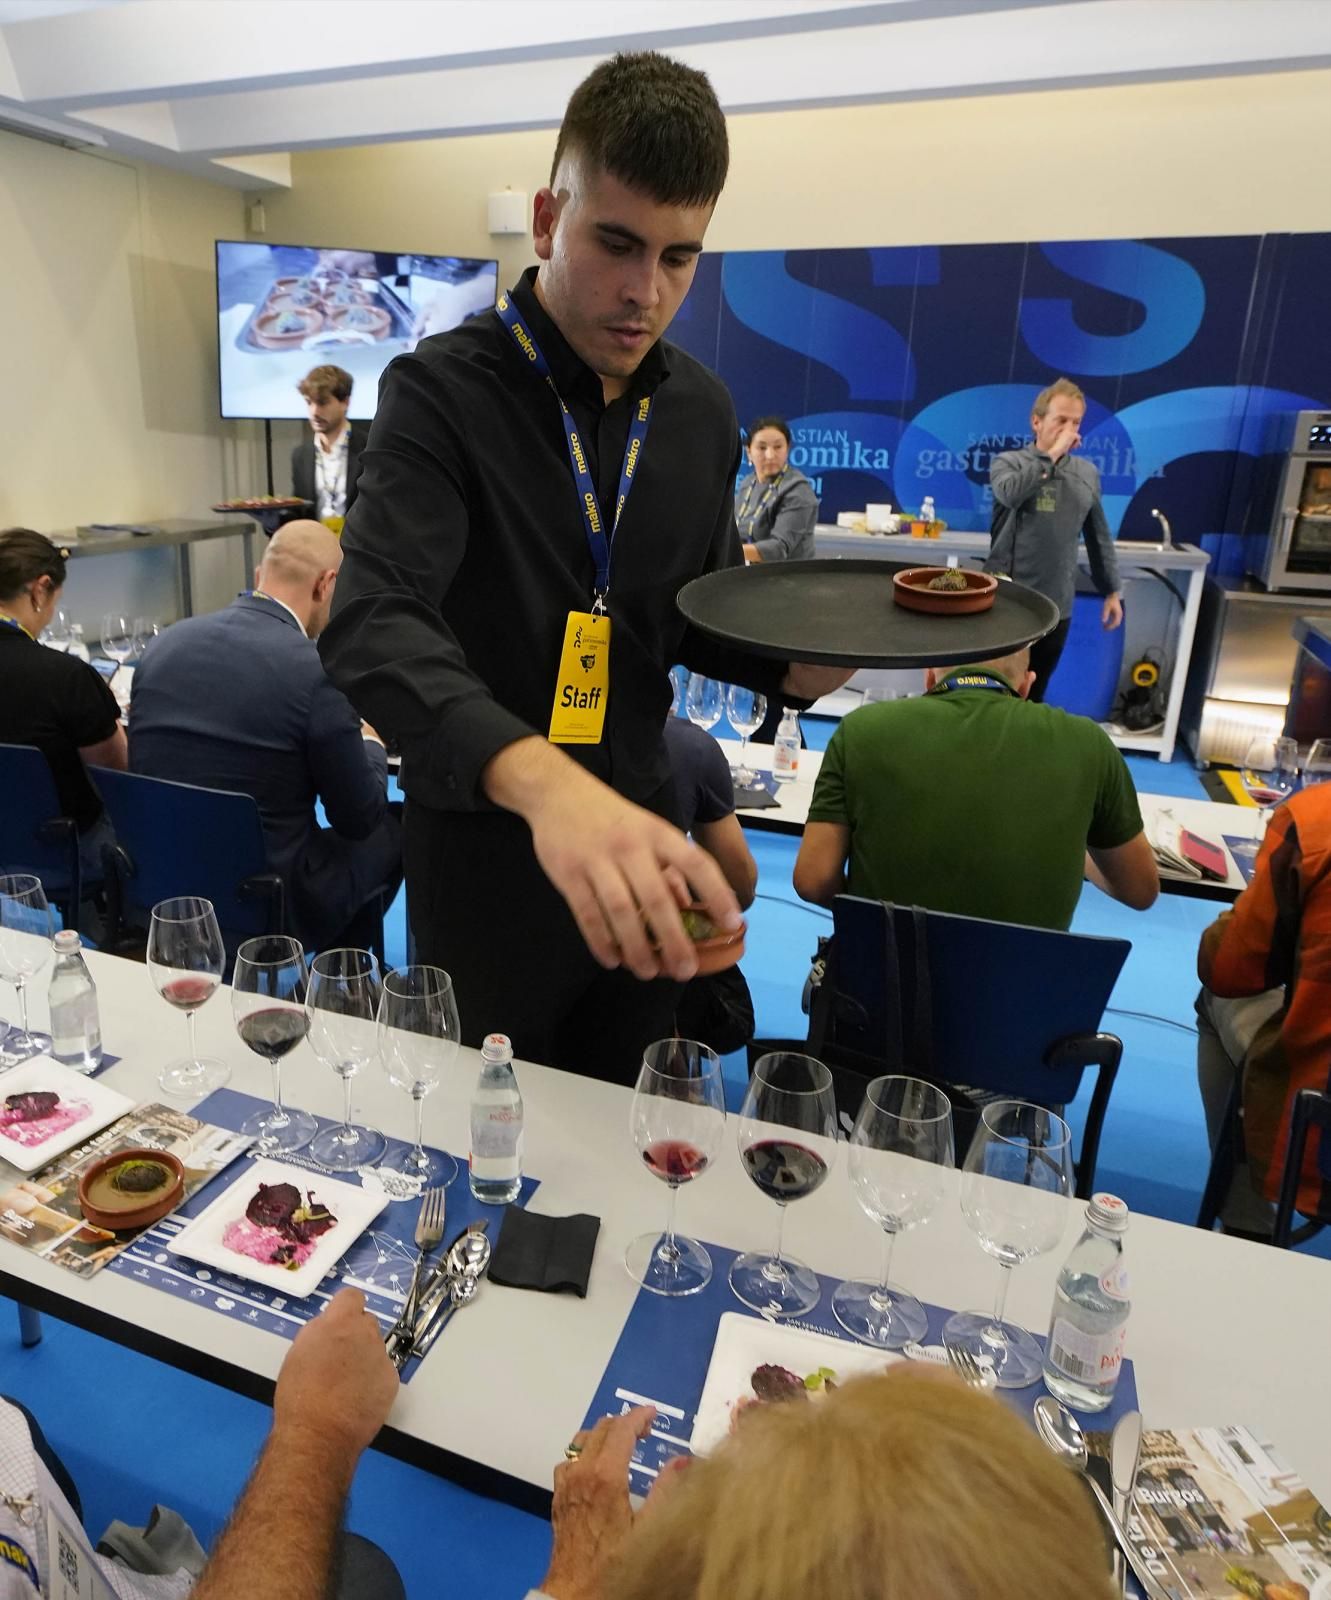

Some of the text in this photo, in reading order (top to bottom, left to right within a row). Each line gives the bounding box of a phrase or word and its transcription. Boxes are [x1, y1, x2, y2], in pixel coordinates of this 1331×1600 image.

[512, 323, 537, 361] makro
[570, 432, 587, 474] makro
[968, 433, 1007, 448] SAN
[625, 438, 641, 478] makro
[584, 492, 601, 533] makro
[956, 676, 988, 686] makro
[560, 685, 602, 710] Staff
[1139, 1487, 1206, 1510] Burgos
